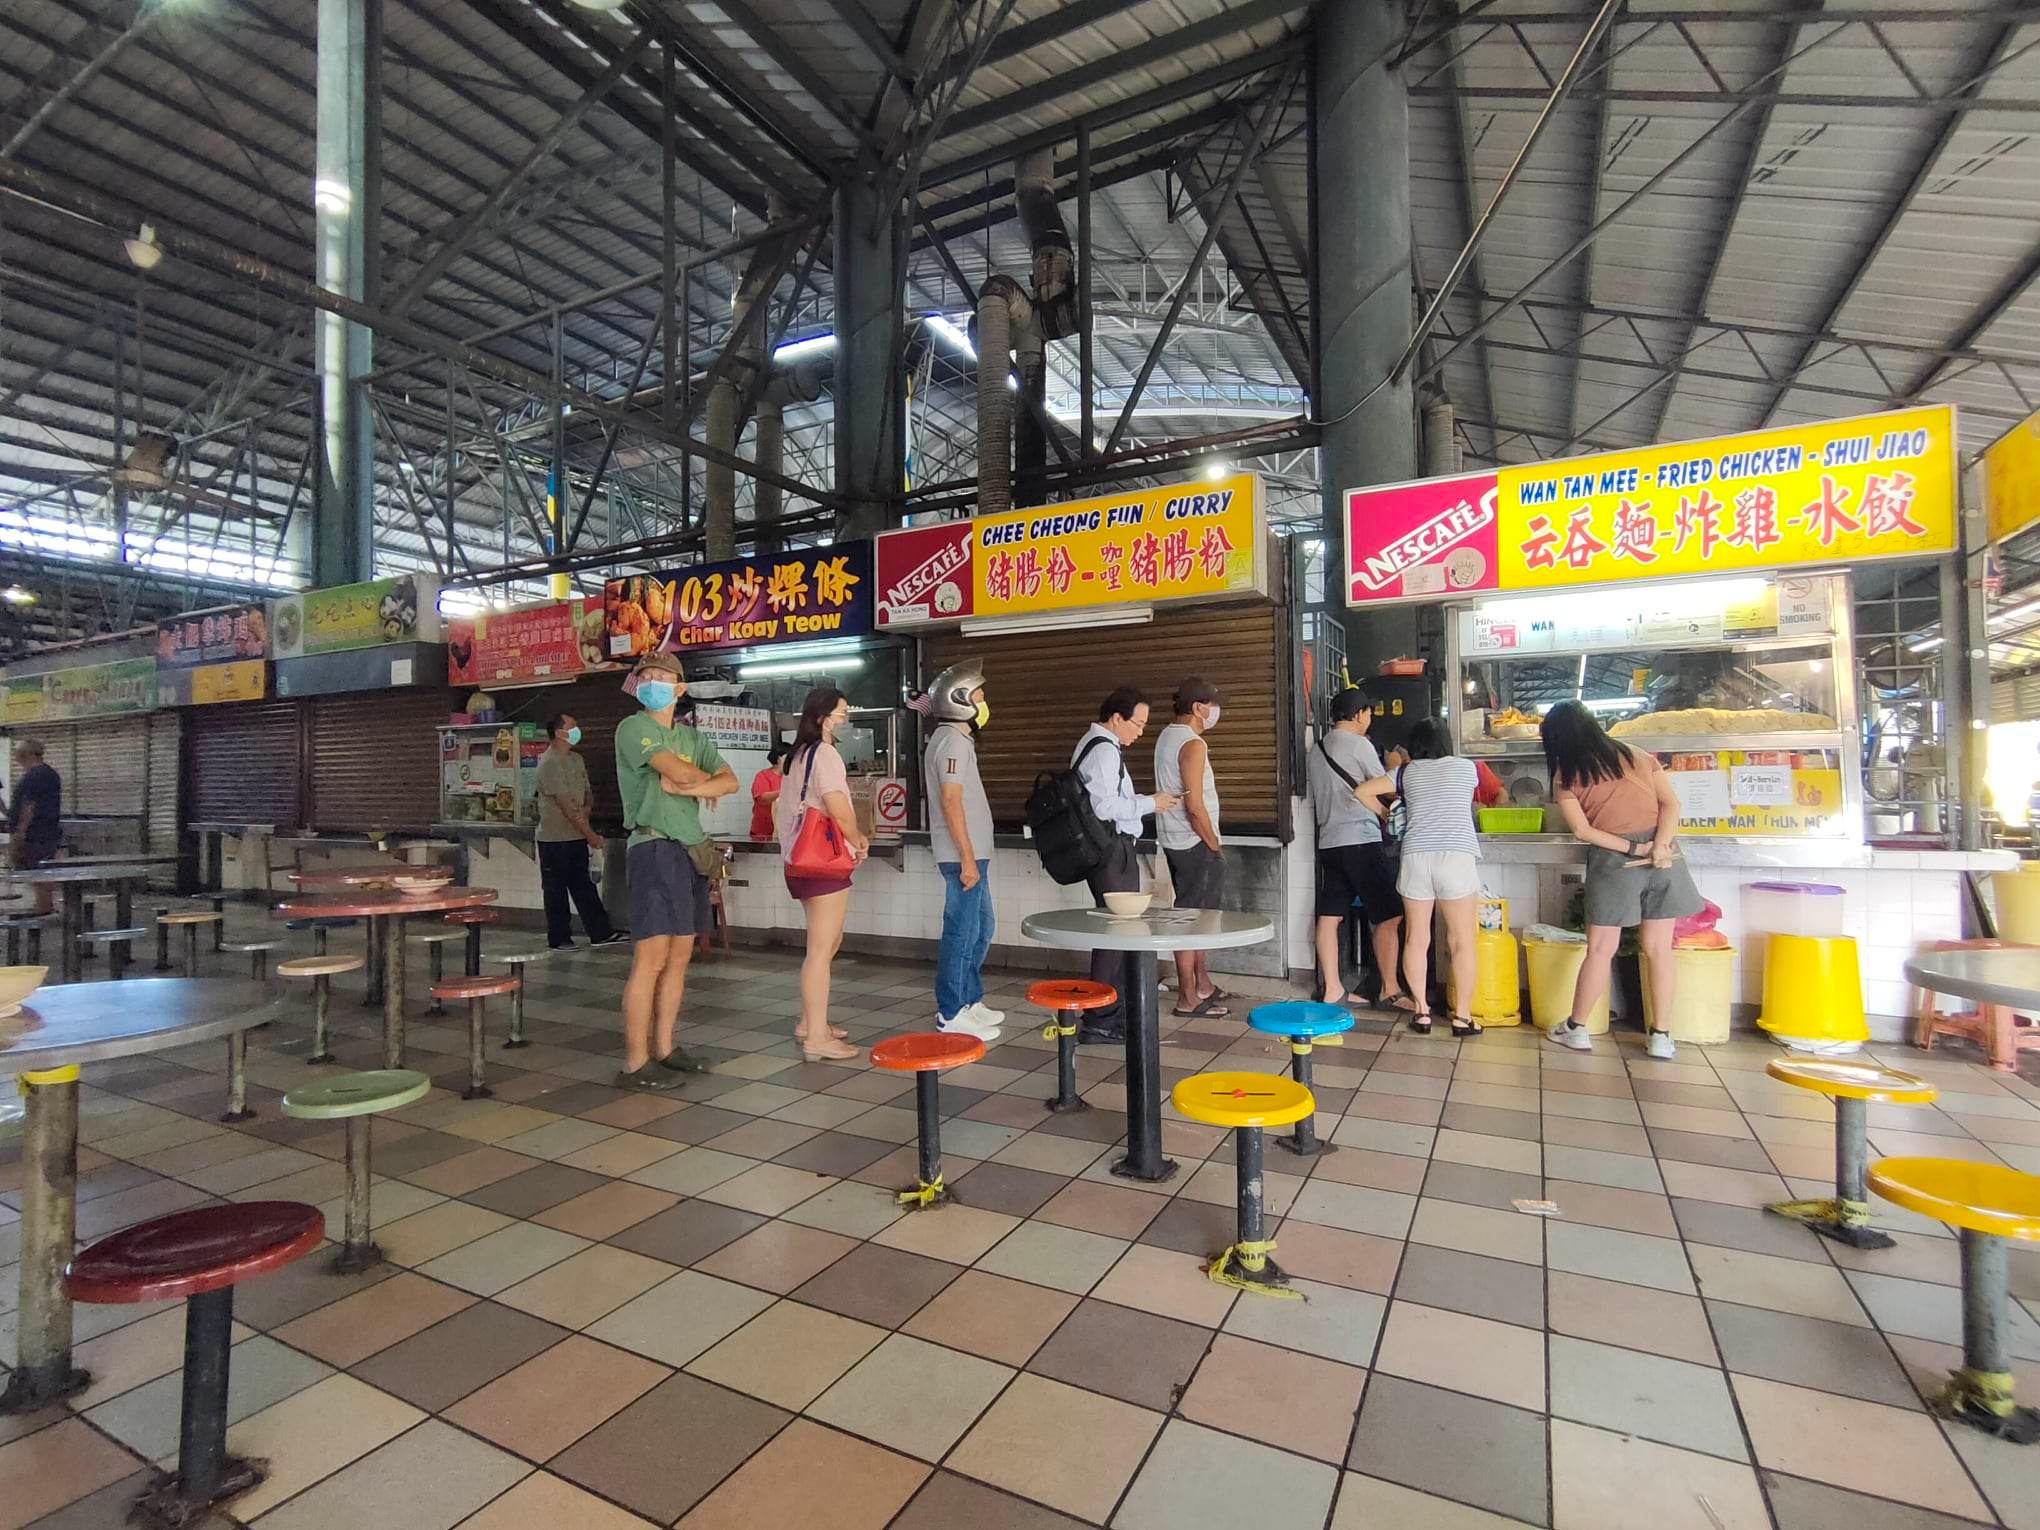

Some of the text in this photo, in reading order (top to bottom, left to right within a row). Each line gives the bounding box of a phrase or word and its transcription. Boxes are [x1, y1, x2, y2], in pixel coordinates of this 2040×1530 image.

[1520, 480, 1557, 504] WAN
[1563, 475, 1594, 499] TAN
[1600, 468, 1638, 494] MEE
[1657, 459, 1713, 488] FRIED
[1720, 446, 1802, 479] CHICKEN
[1824, 437, 1871, 466] SHUI
[1877, 430, 1926, 459] JIAO
[983, 522, 1025, 547] CHEE
[1030, 510, 1101, 538] CHEONG
[1107, 504, 1144, 528] FUN
[1165, 491, 1233, 519] CURRY
[1363, 499, 1481, 582] NESCAFÉ
[1779, 613, 1821, 625] SMOKING
[1792, 603, 1806, 613] NO
[680, 613, 841, 645] Char Koay Teow
[1728, 815, 1756, 828] WAN
